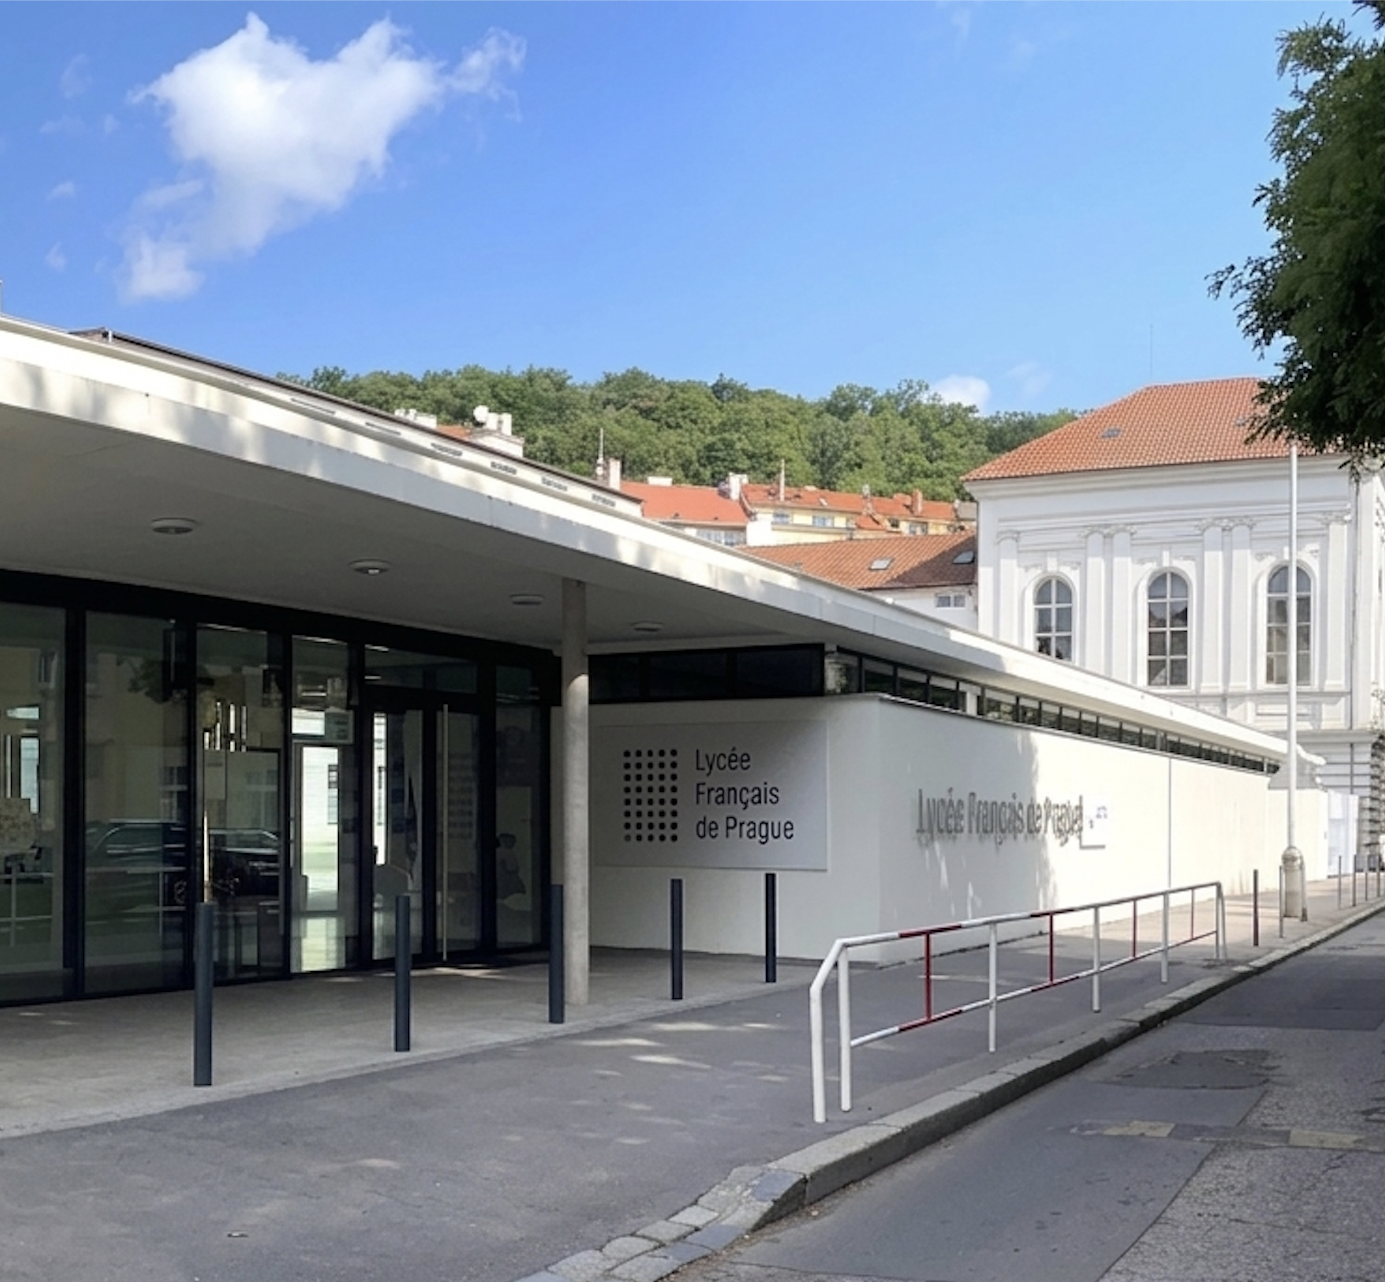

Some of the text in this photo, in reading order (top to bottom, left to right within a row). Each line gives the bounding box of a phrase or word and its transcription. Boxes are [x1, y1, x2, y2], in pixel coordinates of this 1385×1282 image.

[696, 747, 751, 776] Lycée
[696, 781, 780, 810] Français
[696, 816, 795, 845] de Prague
[916, 787, 964, 841] Lycée
[967, 792, 1024, 845] Français
[1026, 797, 1042, 834] de
